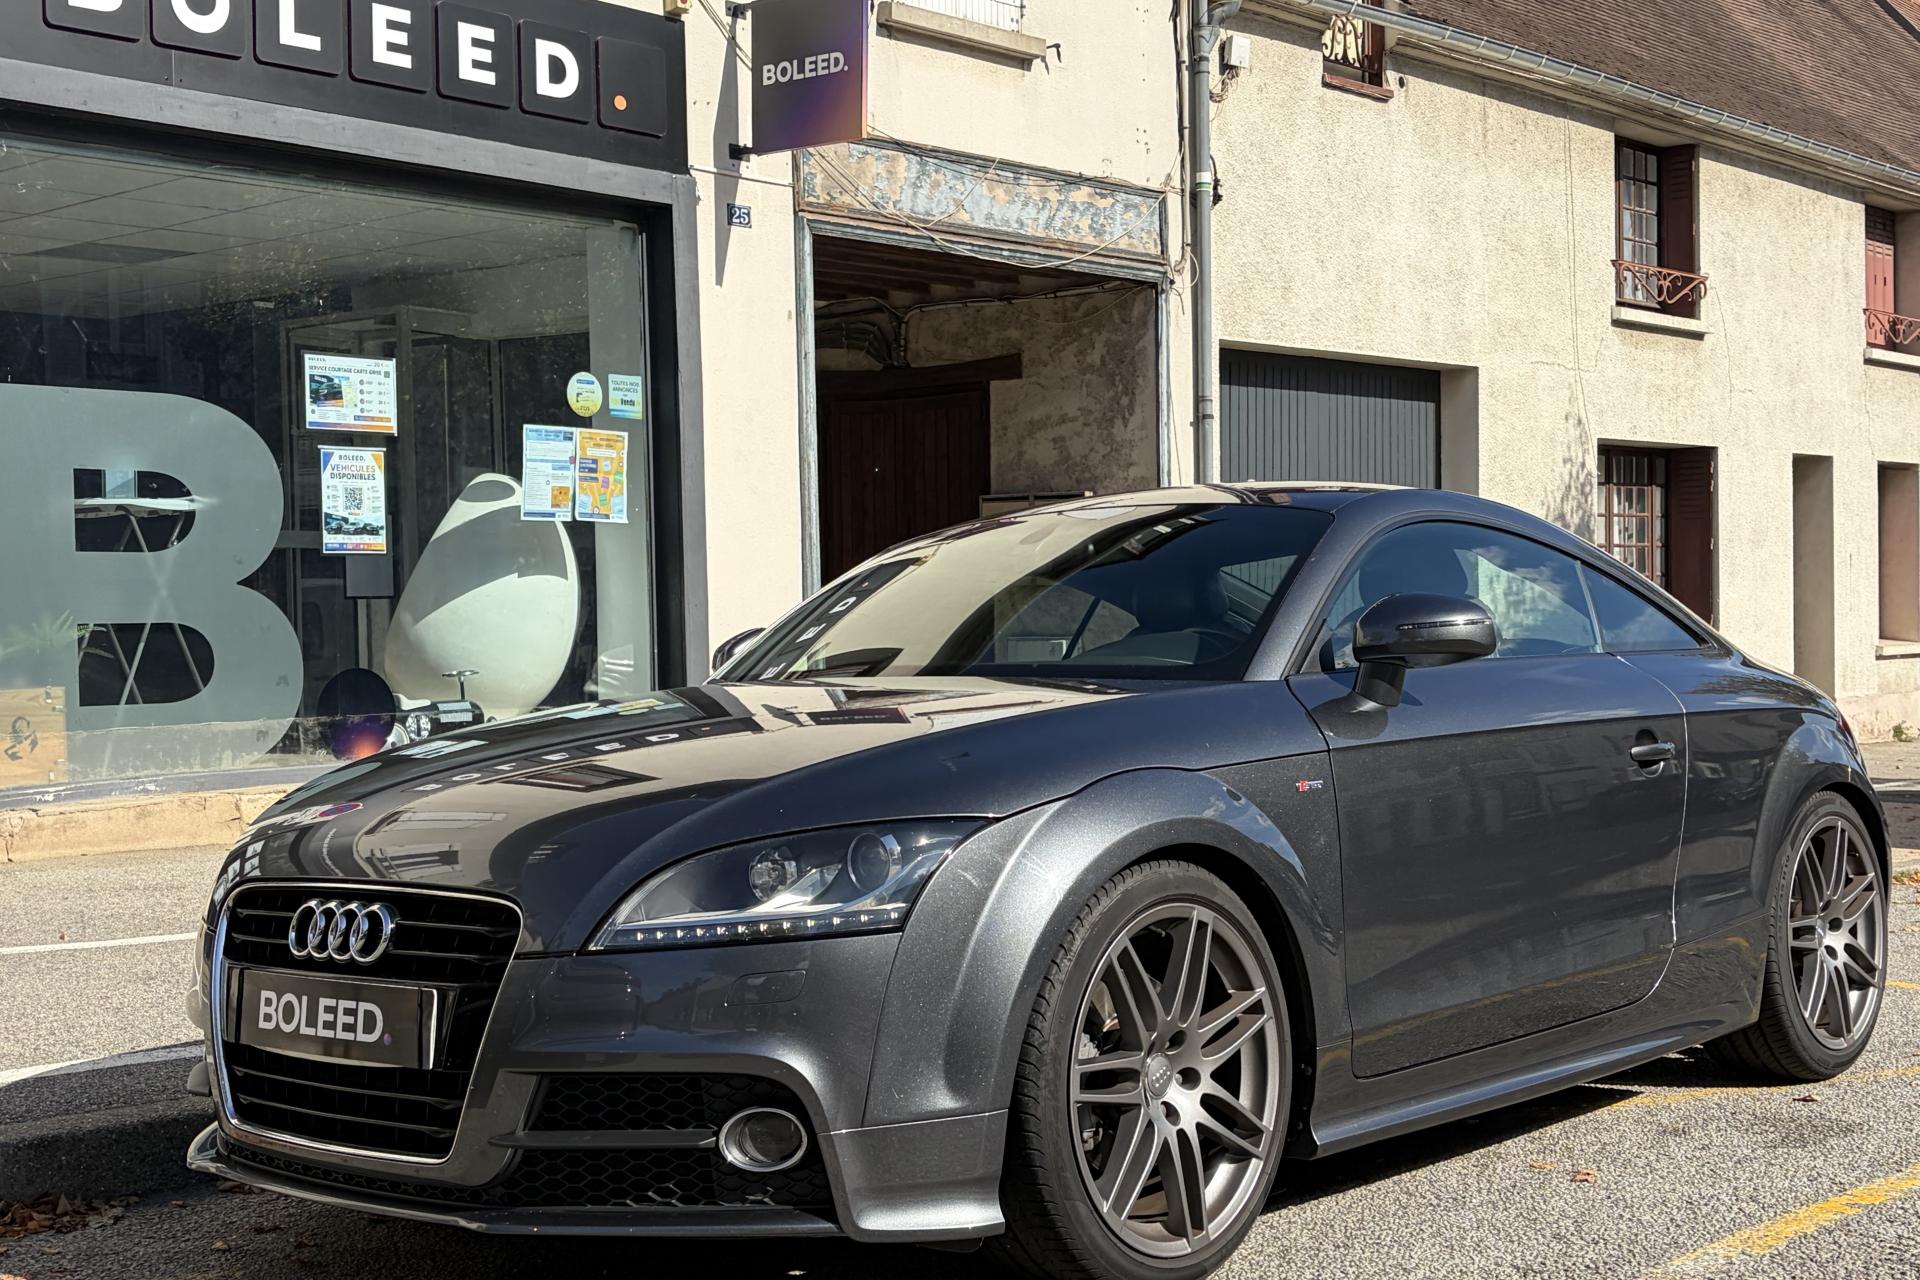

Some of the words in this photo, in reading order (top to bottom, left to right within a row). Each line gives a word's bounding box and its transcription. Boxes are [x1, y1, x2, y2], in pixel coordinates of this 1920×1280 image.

[66, 0, 628, 111] LEED.
[762, 51, 849, 86] BOLEED.
[731, 207, 749, 224] 25
[329, 472, 376, 481] DISPONIBLES
